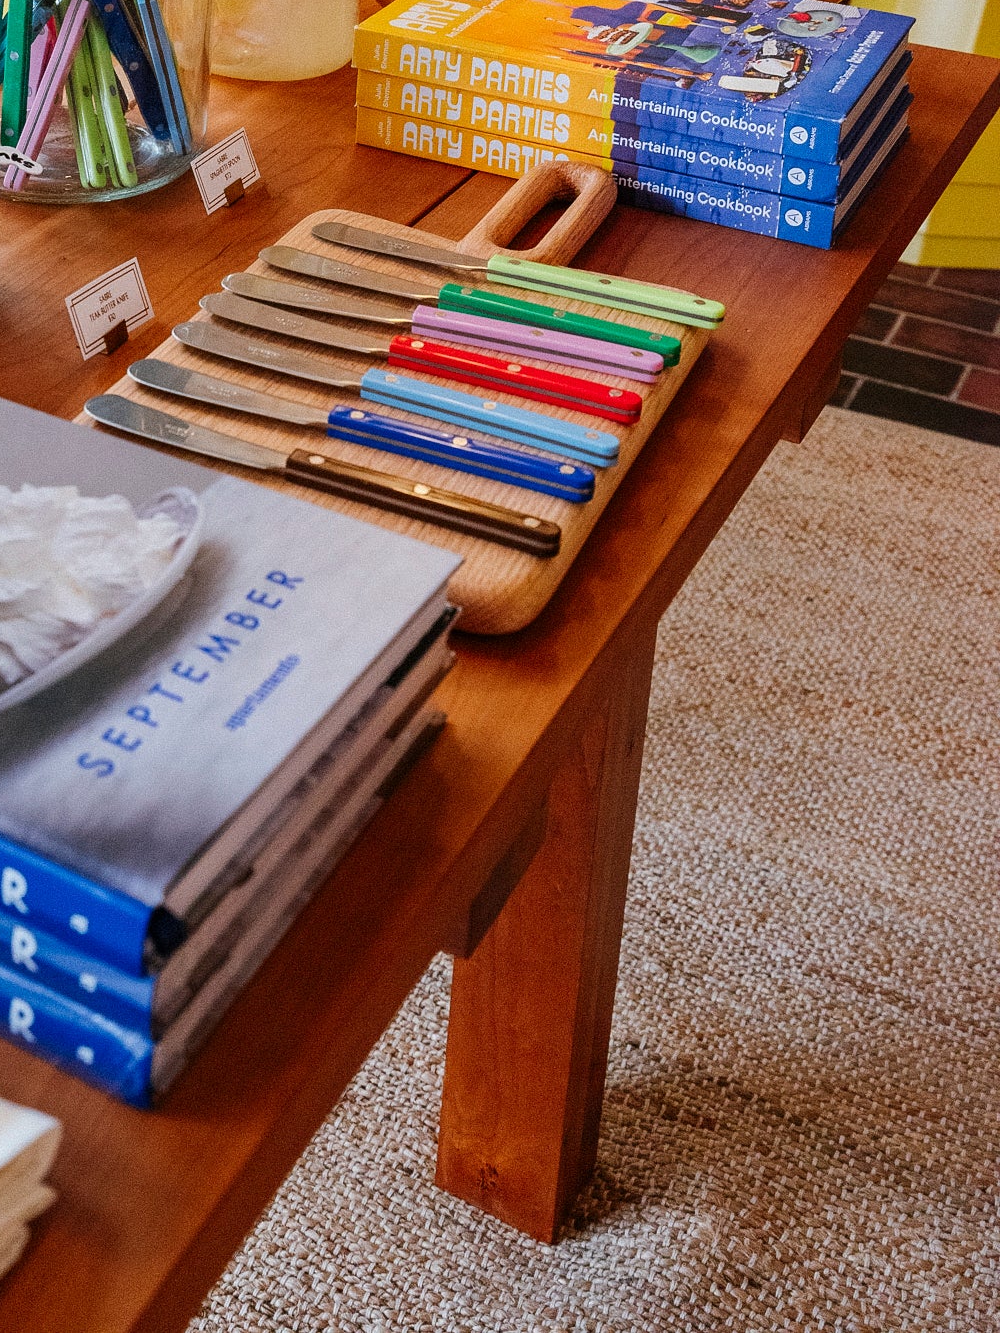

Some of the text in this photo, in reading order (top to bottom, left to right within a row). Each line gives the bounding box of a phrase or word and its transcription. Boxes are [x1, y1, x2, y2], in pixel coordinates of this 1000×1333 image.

[400, 44, 571, 104] ARTY PARTIES
[401, 83, 570, 143] ARTY PARTIES
[587, 88, 776, 136] An Entertaining Cookbook
[403, 122, 569, 174] ARTY PARTI
[587, 128, 774, 178] An Entertaining Cookbook
[611, 173, 771, 219] Entertaining Cookbook
[77, 570, 304, 778] SEPTEMBER
